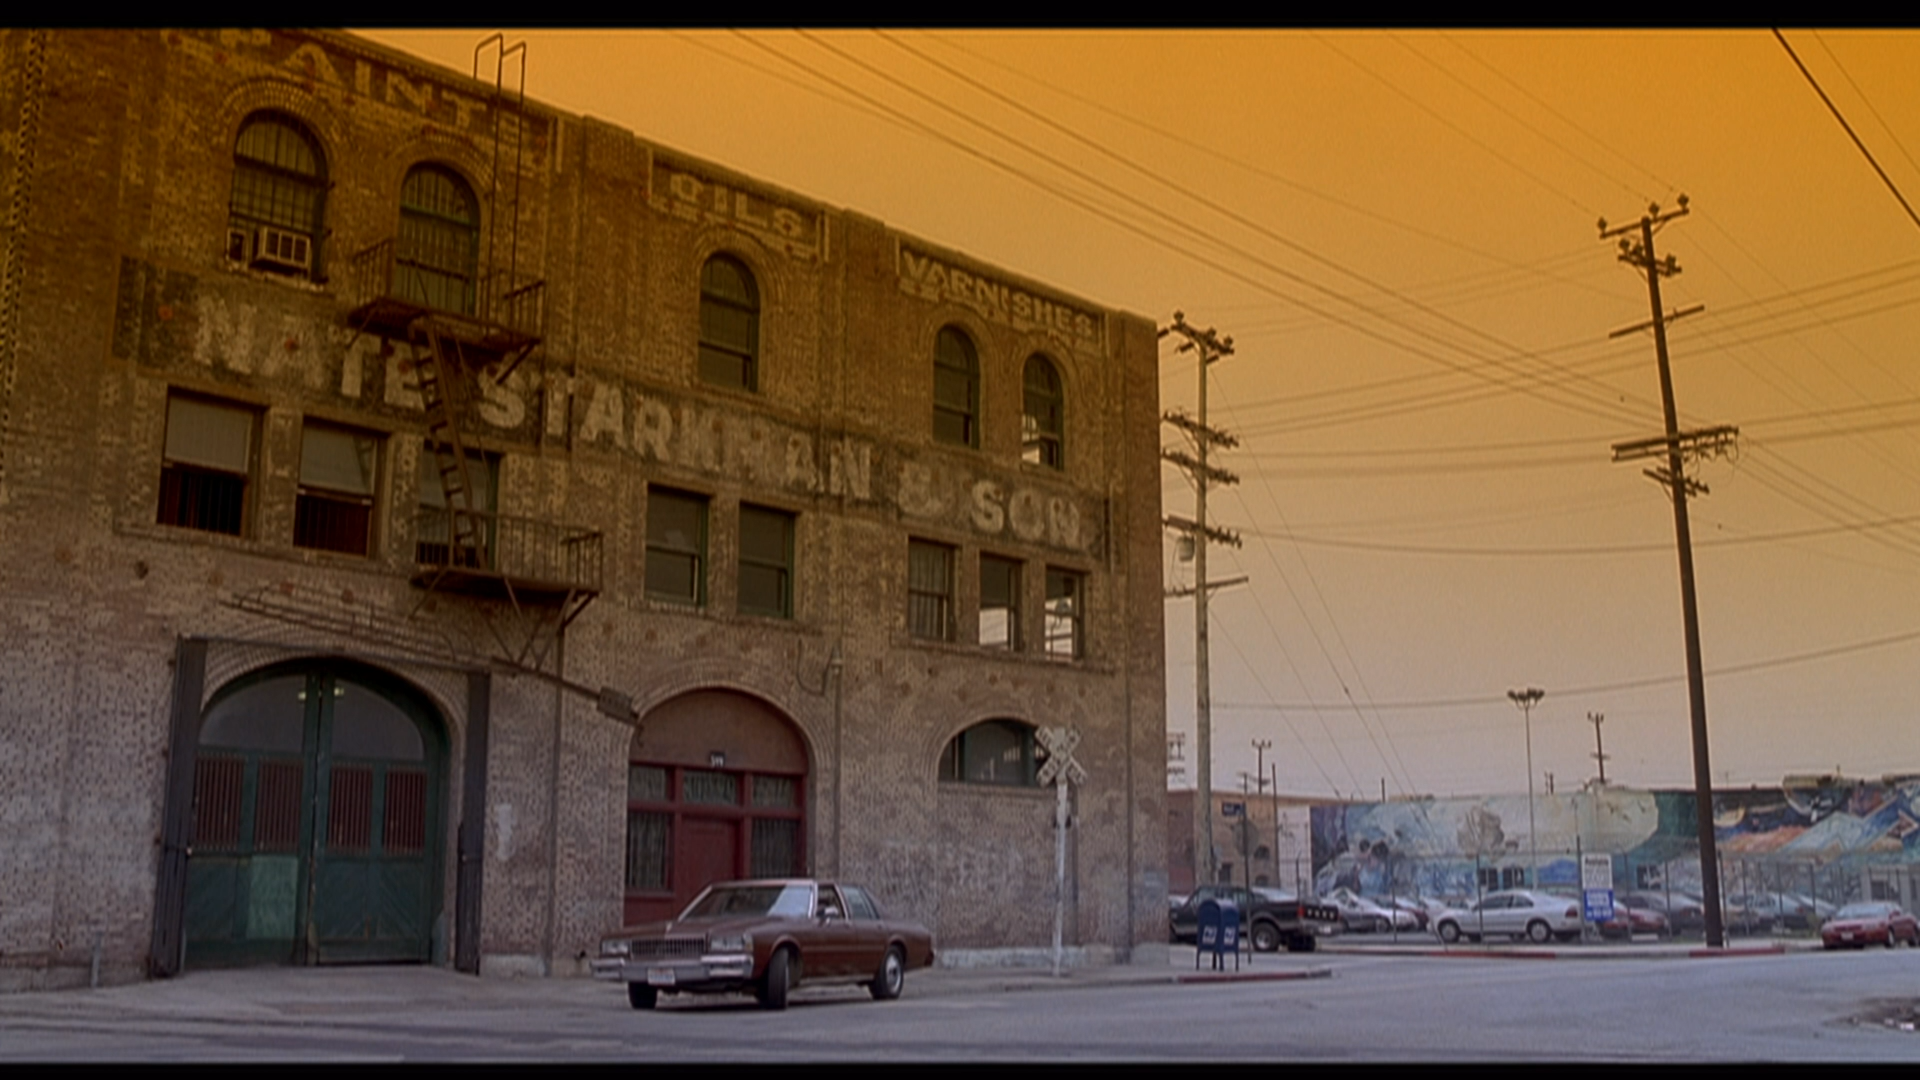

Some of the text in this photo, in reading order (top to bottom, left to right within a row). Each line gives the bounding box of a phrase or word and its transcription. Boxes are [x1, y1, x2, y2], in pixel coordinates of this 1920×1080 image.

[669, 173, 803, 238] OILS
[901, 249, 1093, 339] VARNISHES
[971, 480, 1080, 548] SON
